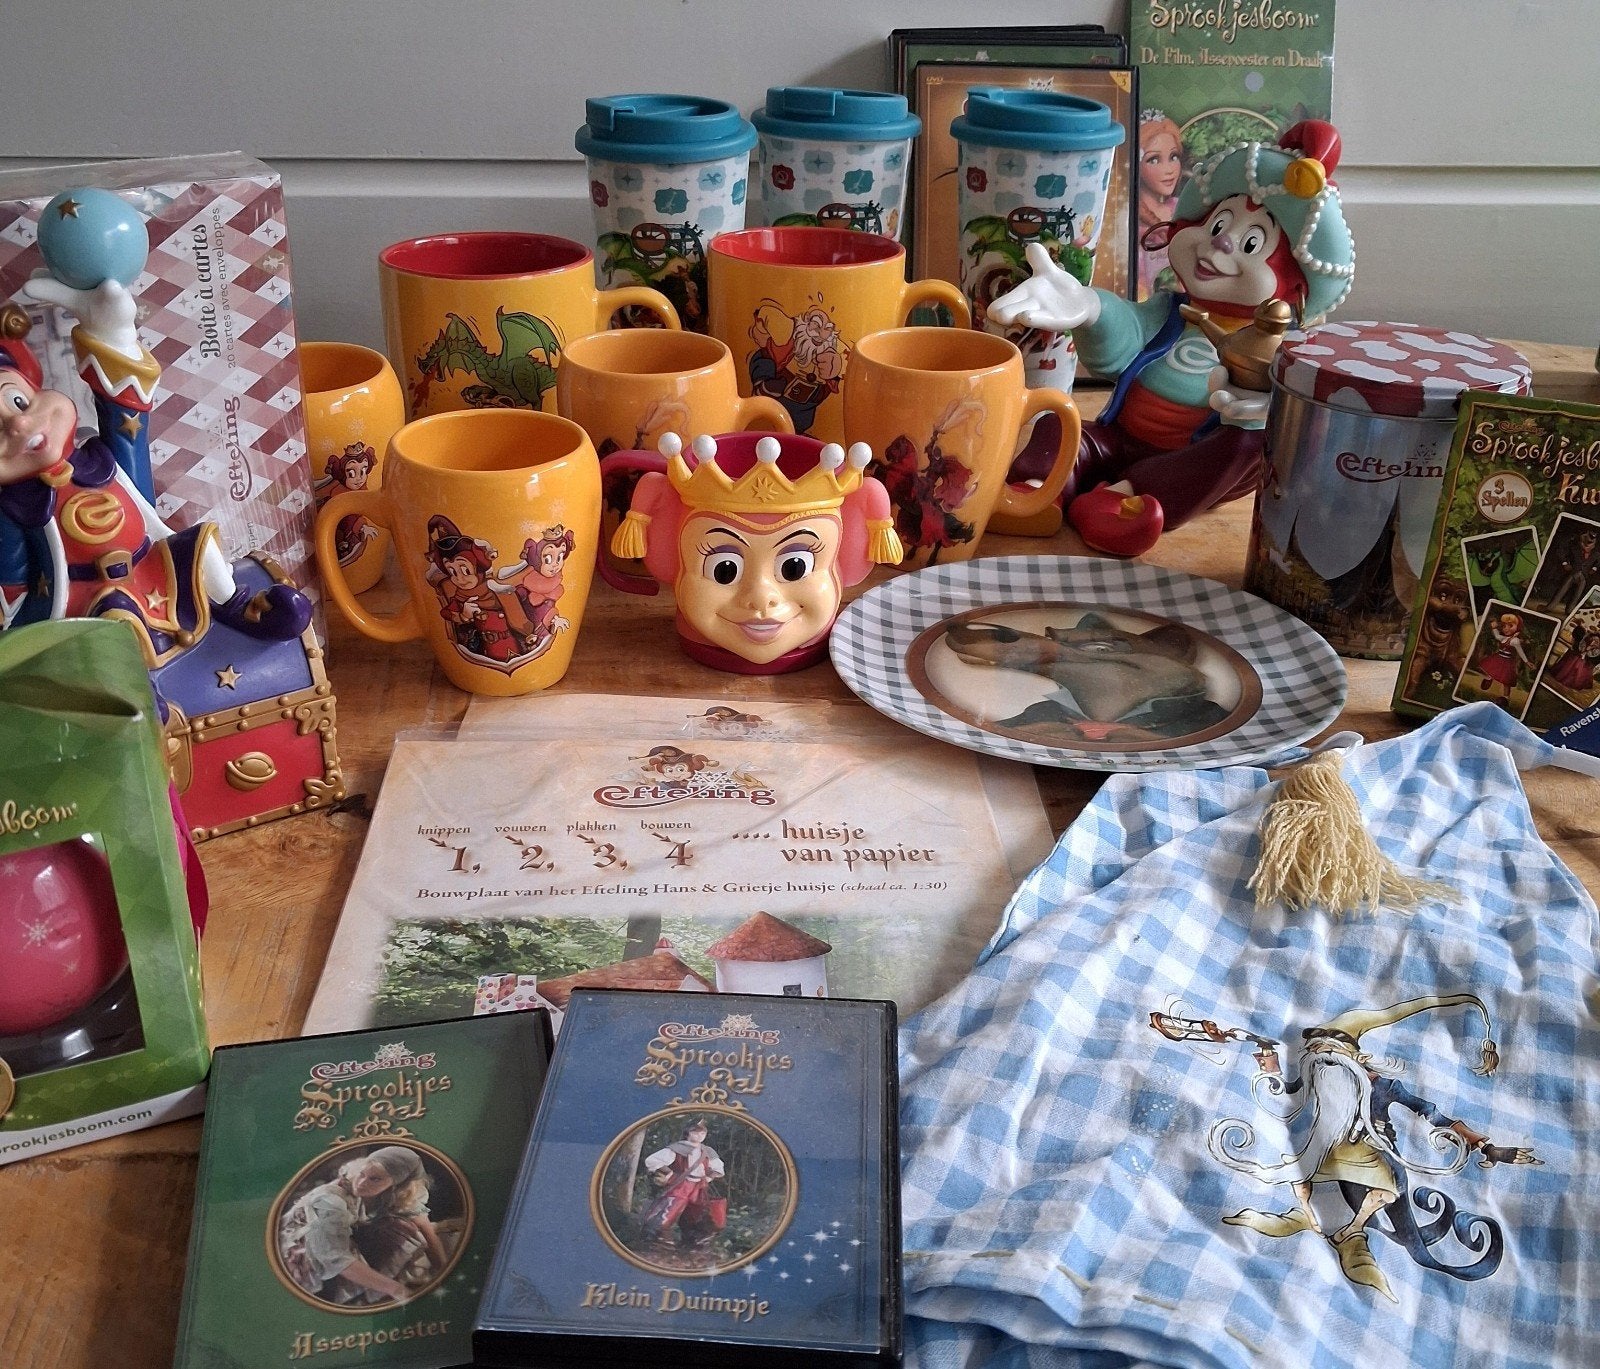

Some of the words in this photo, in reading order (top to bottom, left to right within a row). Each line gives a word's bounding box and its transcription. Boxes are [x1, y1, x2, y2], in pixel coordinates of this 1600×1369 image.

[1150, 0, 1316, 44] Sprookjesboom
[1140, 47, 1160, 65] De
[1199, 47, 1269, 68] Assepoester
[1272, 56, 1286, 67] en
[1287, 49, 1324, 68] Draak
[191, 224, 212, 283] cartes
[211, 207, 227, 280] enveloppes
[194, 285, 214, 300] à
[220, 284, 230, 311] avec
[198, 303, 221, 359] Boîte
[223, 315, 234, 351] cartes
[227, 355, 236, 369] 20
[1481, 490, 1529, 513] Spellen
[1494, 478, 1505, 494] 3
[417, 825, 472, 838] knippen
[494, 823, 547, 833] vouwen
[566, 821, 617, 835] plakken
[640, 820, 692, 830] bouwen
[664, 840, 694, 869] 4
[781, 819, 866, 846] huisje
[780, 848, 834, 864] van
[843, 843, 936, 872] papier
[416, 887, 510, 901] Bouwplaat
[514, 888, 544, 897] van
[549, 886, 576, 897] het
[582, 884, 649, 897] Efteling
[653, 883, 698, 893] Hans
[702, 883, 717, 893] &
[723, 882, 783, 895] Grietje
[786, 882, 836, 895] huisje
[840, 882, 887, 893] (schaal
[912, 881, 948, 891] 1:30)
[634, 1036, 794, 1095] Sprookjes
[293, 1071, 453, 1131] Sprookjes
[0, 1109, 153, 1154] rookjesboom.com
[580, 1282, 652, 1310] Klein
[658, 1286, 770, 1323] Duimpje
[289, 1318, 451, 1360] Assepoester
